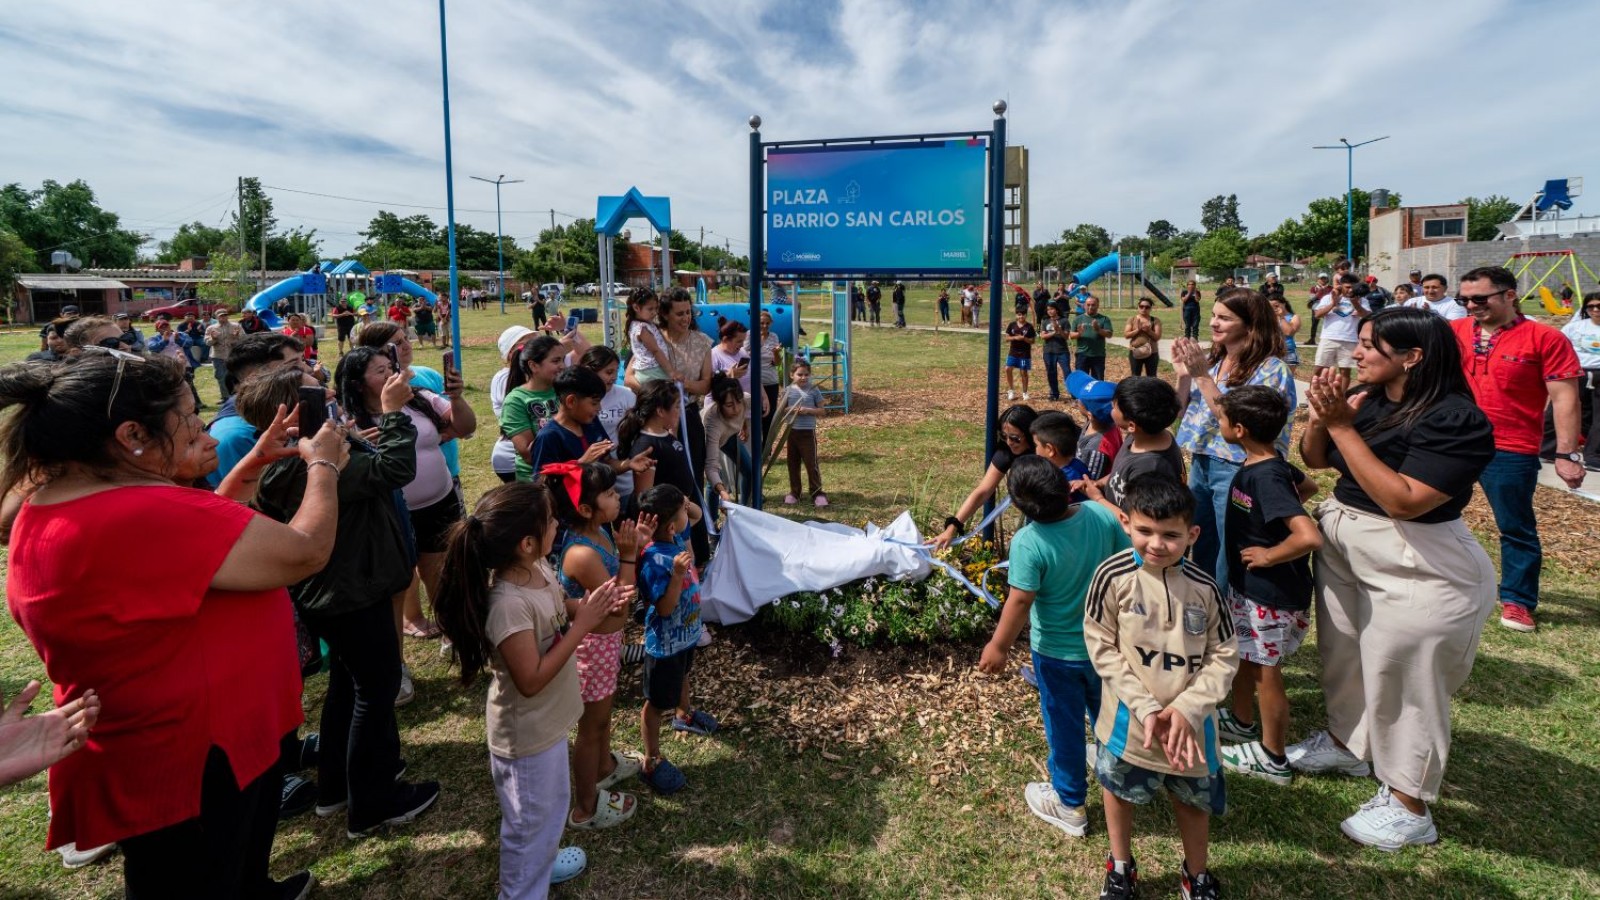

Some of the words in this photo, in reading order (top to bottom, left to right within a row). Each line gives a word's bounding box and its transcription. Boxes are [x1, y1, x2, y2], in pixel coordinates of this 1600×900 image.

[772, 189, 829, 205] PLAZA
[772, 211, 840, 228] BARRIO
[845, 211, 883, 227] SAN
[889, 209, 966, 226] CARLOS
[1133, 645, 1202, 674] YPF
